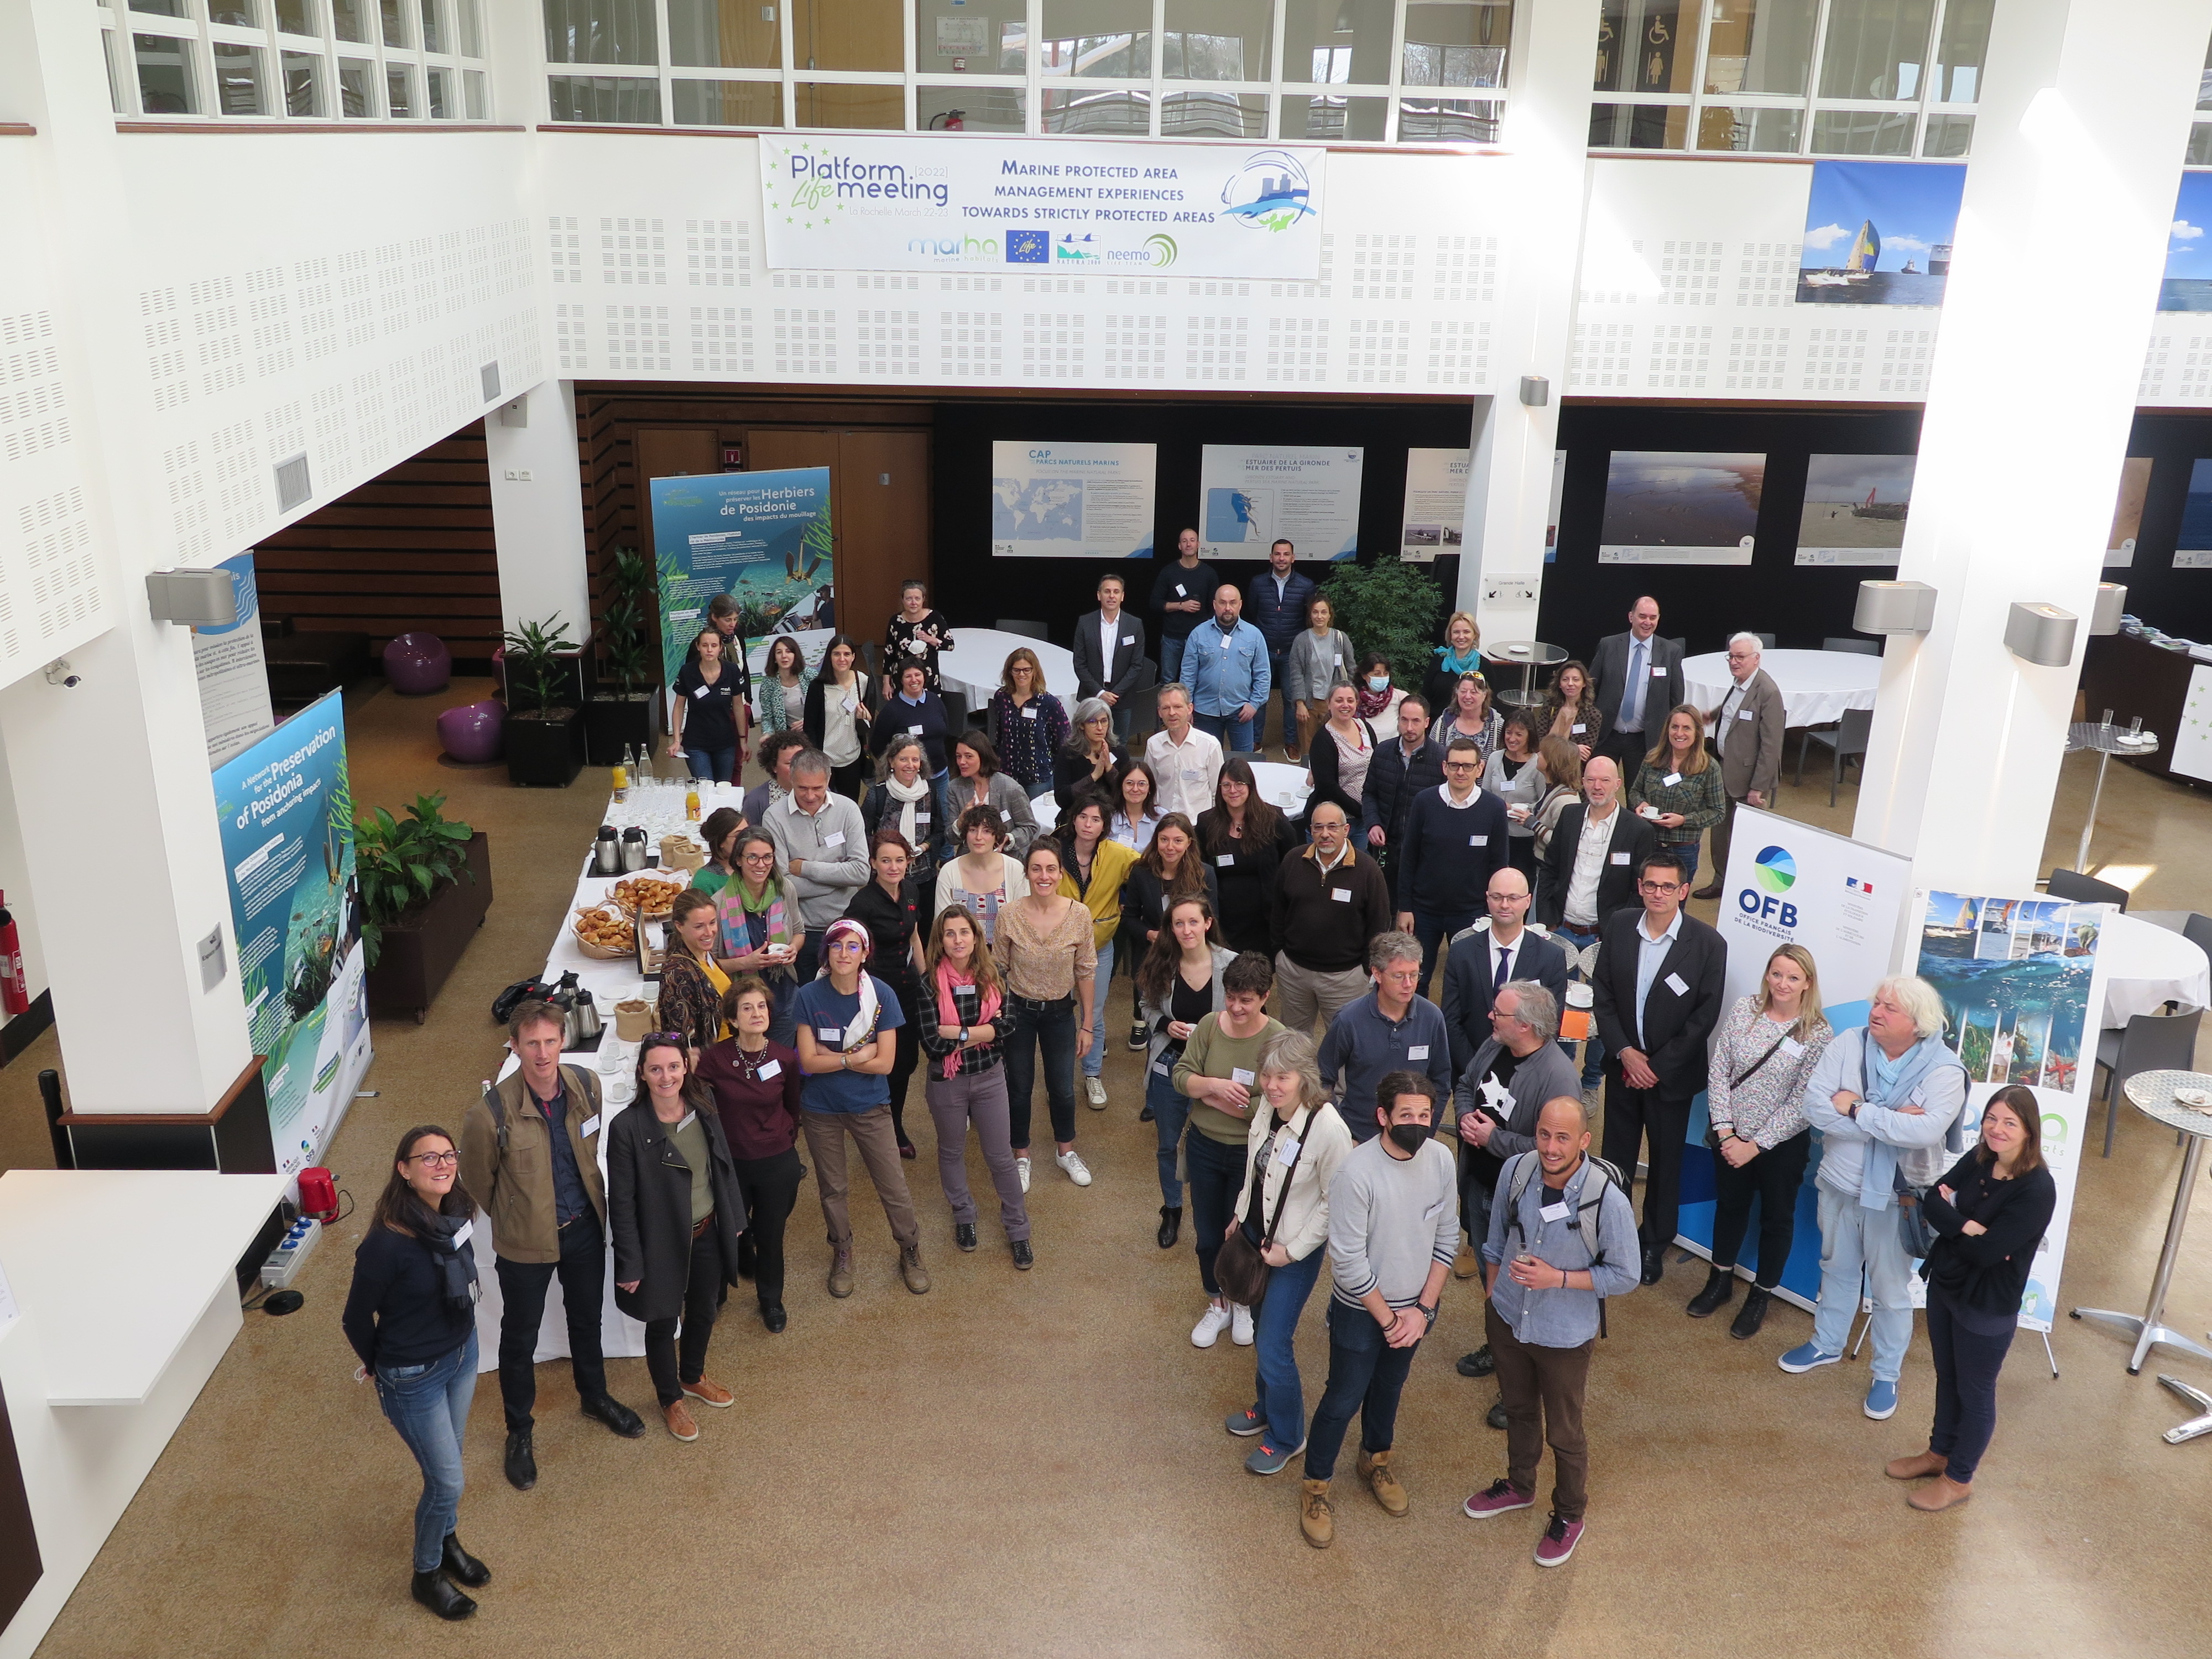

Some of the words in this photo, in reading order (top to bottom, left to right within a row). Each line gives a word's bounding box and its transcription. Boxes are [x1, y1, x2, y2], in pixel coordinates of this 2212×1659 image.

[791, 155, 905, 180] Platform
[915, 166, 948, 178] [2022]
[1001, 160, 1060, 177] MARINE
[1065, 166, 1138, 179] PROTECTED
[1144, 168, 1178, 180] AREA
[791, 173, 834, 210] Life
[838, 176, 948, 207] meeting
[994, 186, 1093, 199] MANAGEMENT
[1098, 187, 1183, 201] EXPERIENCES
[849, 207, 858, 216] La
[860, 207, 892, 216] Rochelle
[894, 208, 921, 217] March
[924, 208, 948, 217] 22-23
[962, 206, 1029, 219] TOWARDS
[1034, 207, 1089, 220] STRICTLY
[1095, 209, 1168, 222] PROTECTED
[1173, 211, 1215, 223] AREAS
[909, 232, 998, 255] marha
[1019, 238, 1037, 254] Life
[1107, 251, 1150, 261] neemo
[1029, 450, 1051, 458] CAP
[761, 486, 815, 499] Herbiers
[720, 504, 735, 515] de
[739, 500, 796, 514] Posidonie
[254, 784, 263, 794] for
[263, 777, 273, 787] the
[271, 726, 336, 781] Preservation
[242, 781, 247, 790] A
[247, 765, 270, 786] Network
[237, 805, 249, 830] of
[251, 772, 303, 820] Posidonia
[261, 813, 276, 828] from
[276, 792, 302, 817] anchoring
[302, 778, 321, 797] impacts
[1739, 889, 1798, 928] OFB
[1739, 912, 1760, 925] OFFICE
[1760, 919, 1792, 936] FRANÇAIS
[1752, 923, 1794, 943] BIODIVERSITÉ
